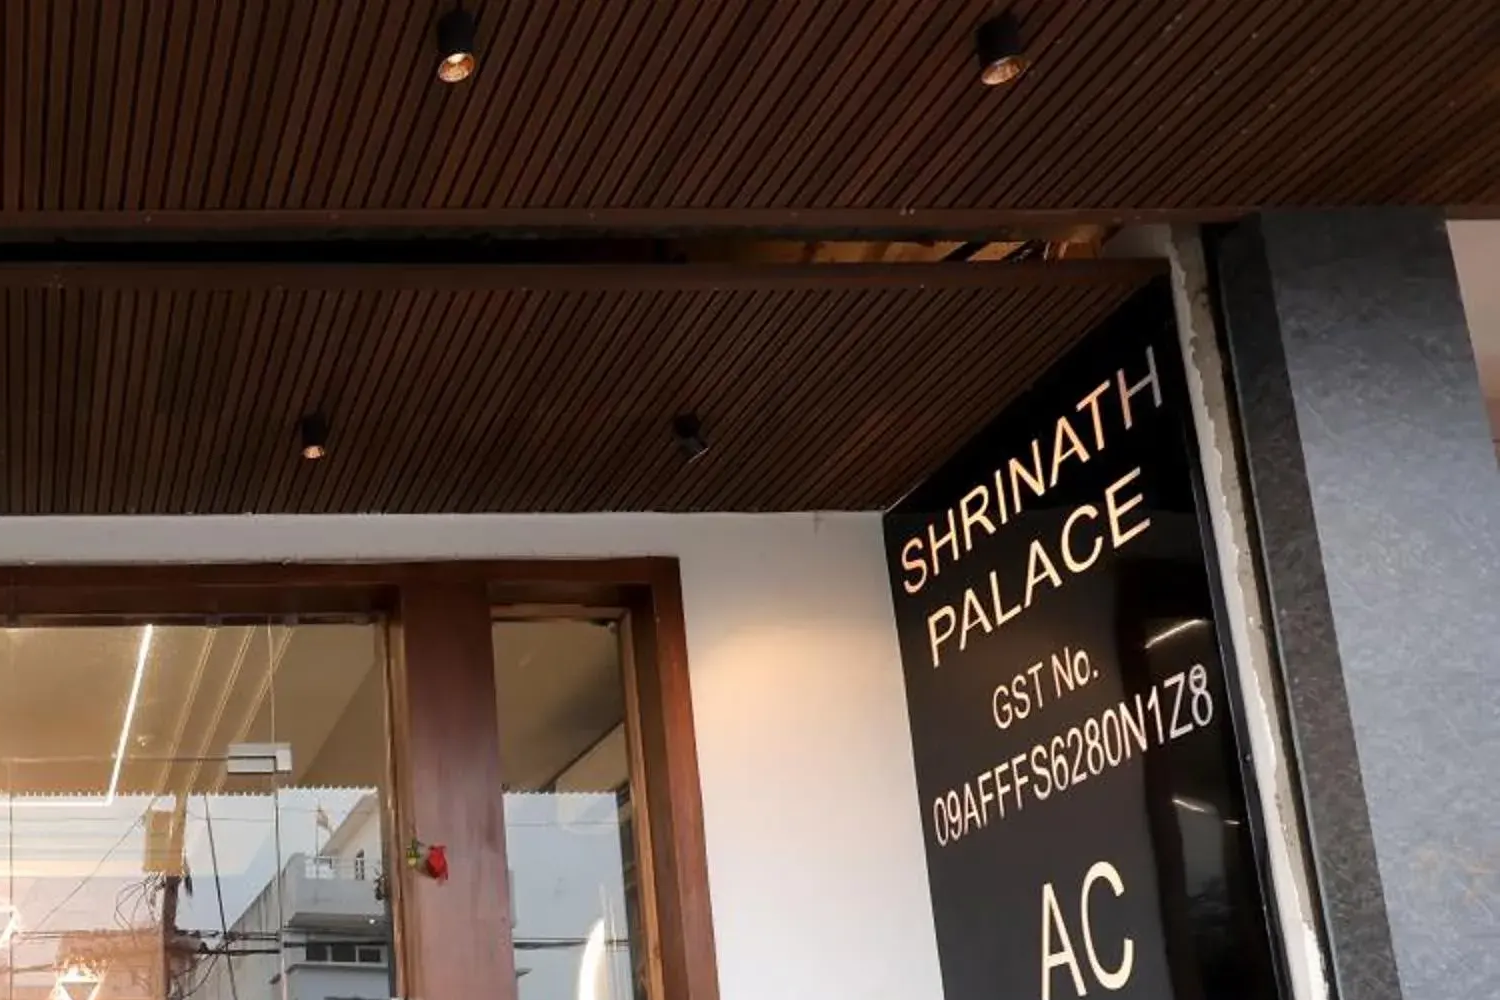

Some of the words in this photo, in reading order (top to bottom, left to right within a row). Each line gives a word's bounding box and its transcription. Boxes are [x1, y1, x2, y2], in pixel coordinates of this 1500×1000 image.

[900, 345, 1162, 594] SHRINATH
[926, 467, 1151, 668] PALACE
[932, 665, 1214, 847] 09AFFFS6280N1Z8
[993, 662, 1044, 729] GST
[1051, 645, 1099, 698] No.
